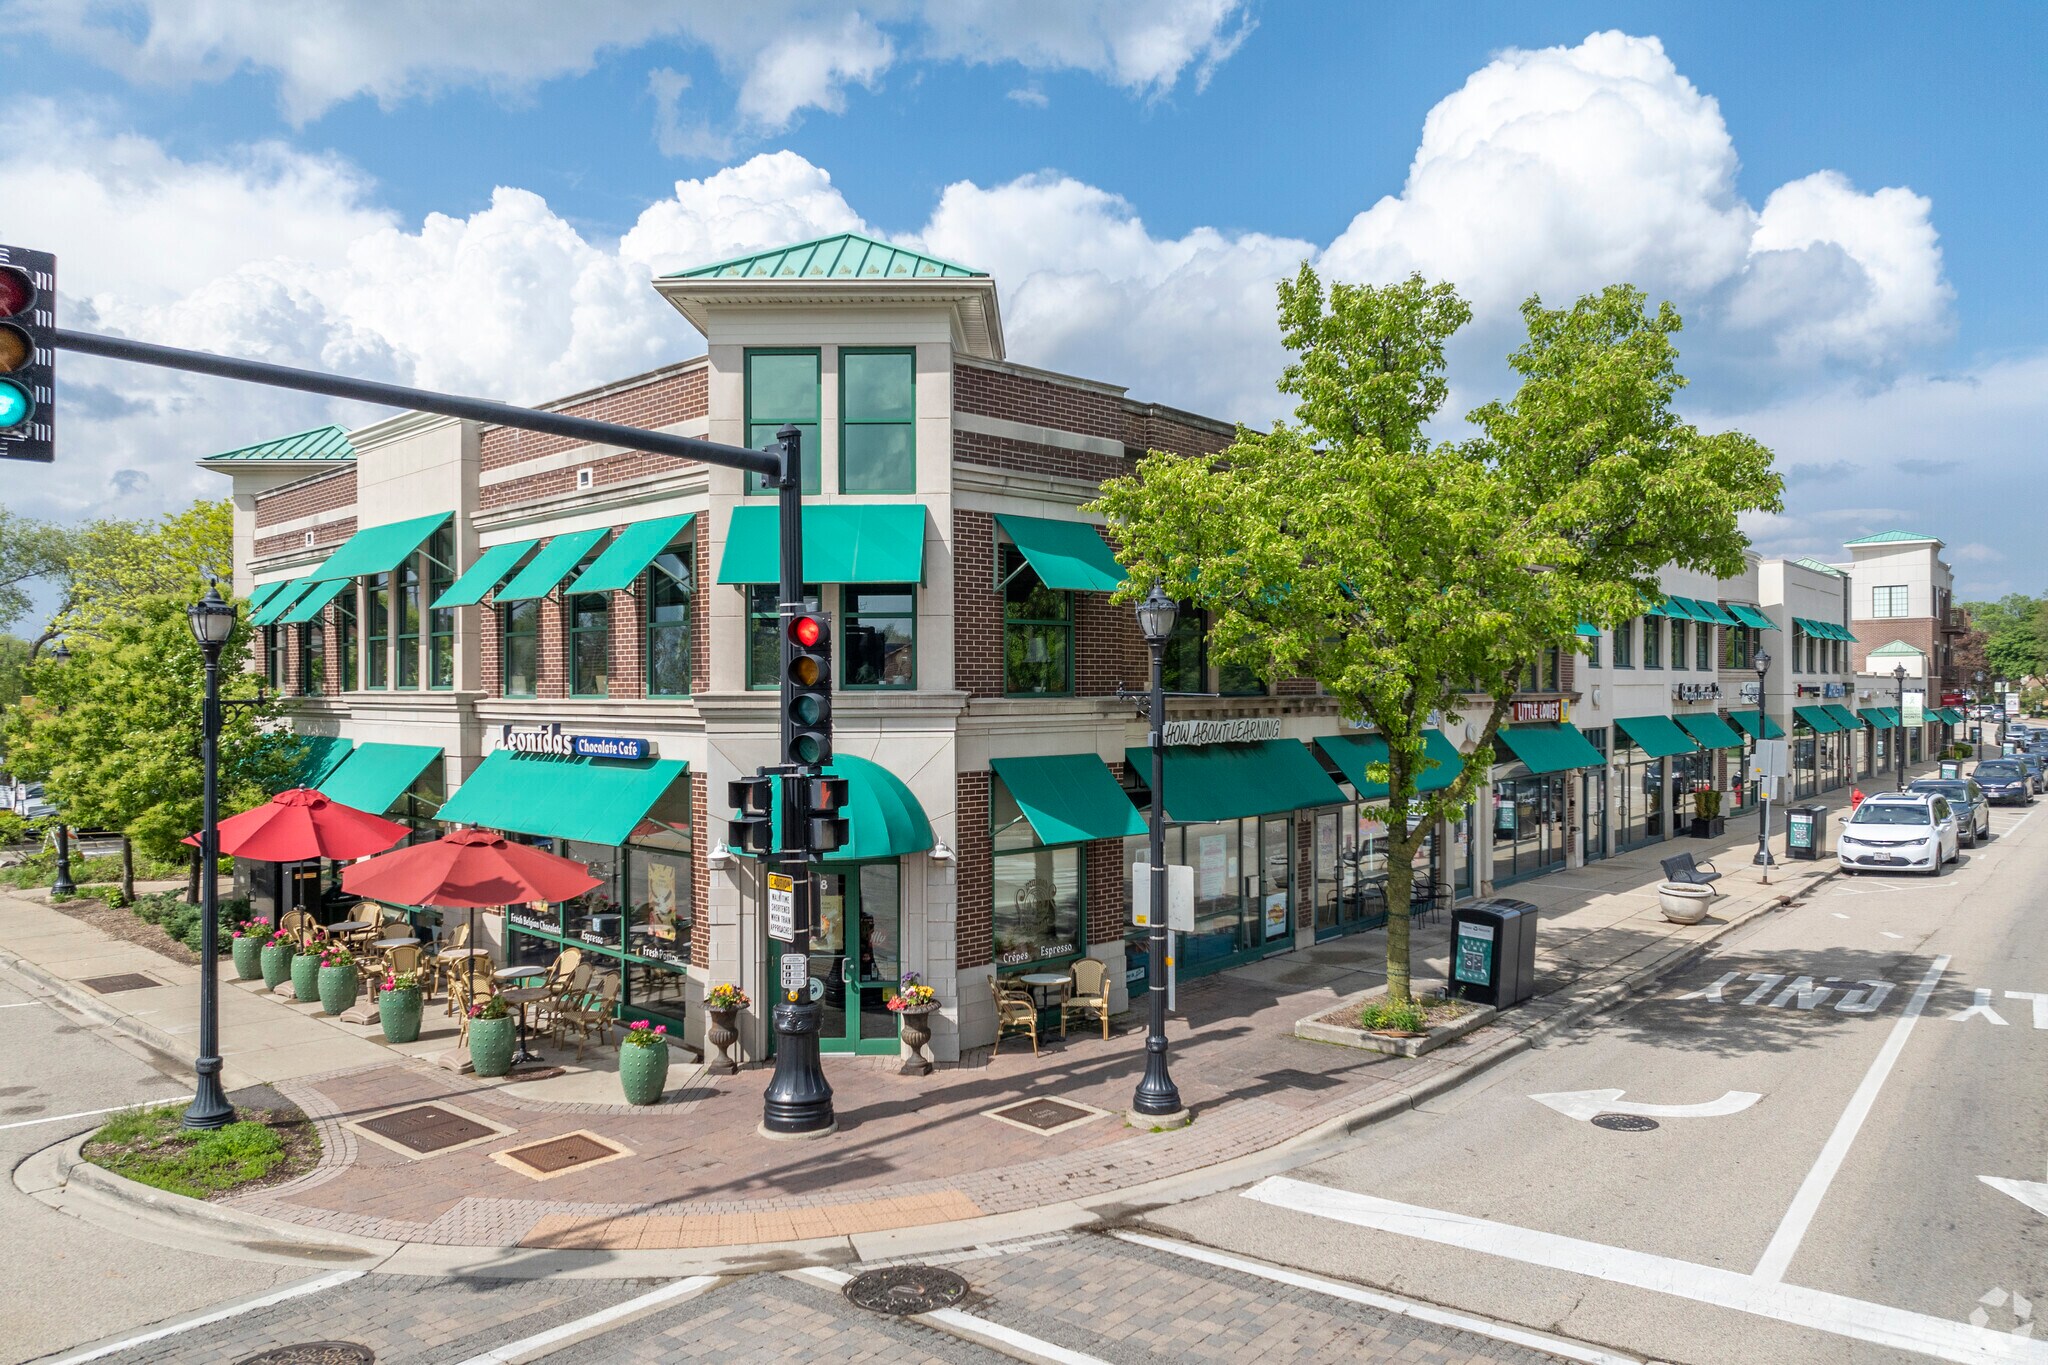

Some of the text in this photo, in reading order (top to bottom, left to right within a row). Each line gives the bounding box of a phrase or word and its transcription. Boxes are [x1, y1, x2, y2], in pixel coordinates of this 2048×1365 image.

[1518, 702, 1538, 721] LITTLE
[495, 723, 573, 755] Leonidas
[1164, 719, 1280, 745] HOW ABOUT LEARNING
[578, 739, 637, 755] Chocolate Café
[771, 904, 790, 914] SHORTENED
[511, 913, 561, 934] Fresh Belgian Chocolate
[771, 914, 790, 924] WHEN TRAIN
[581, 930, 603, 944] Espresso
[771, 924, 791, 935] APPROACHES
[643, 945, 678, 962] Fresh Pastry
[1003, 944, 1072, 963] Crêpes Espresso
[1675, 971, 1897, 1013] ONLY
